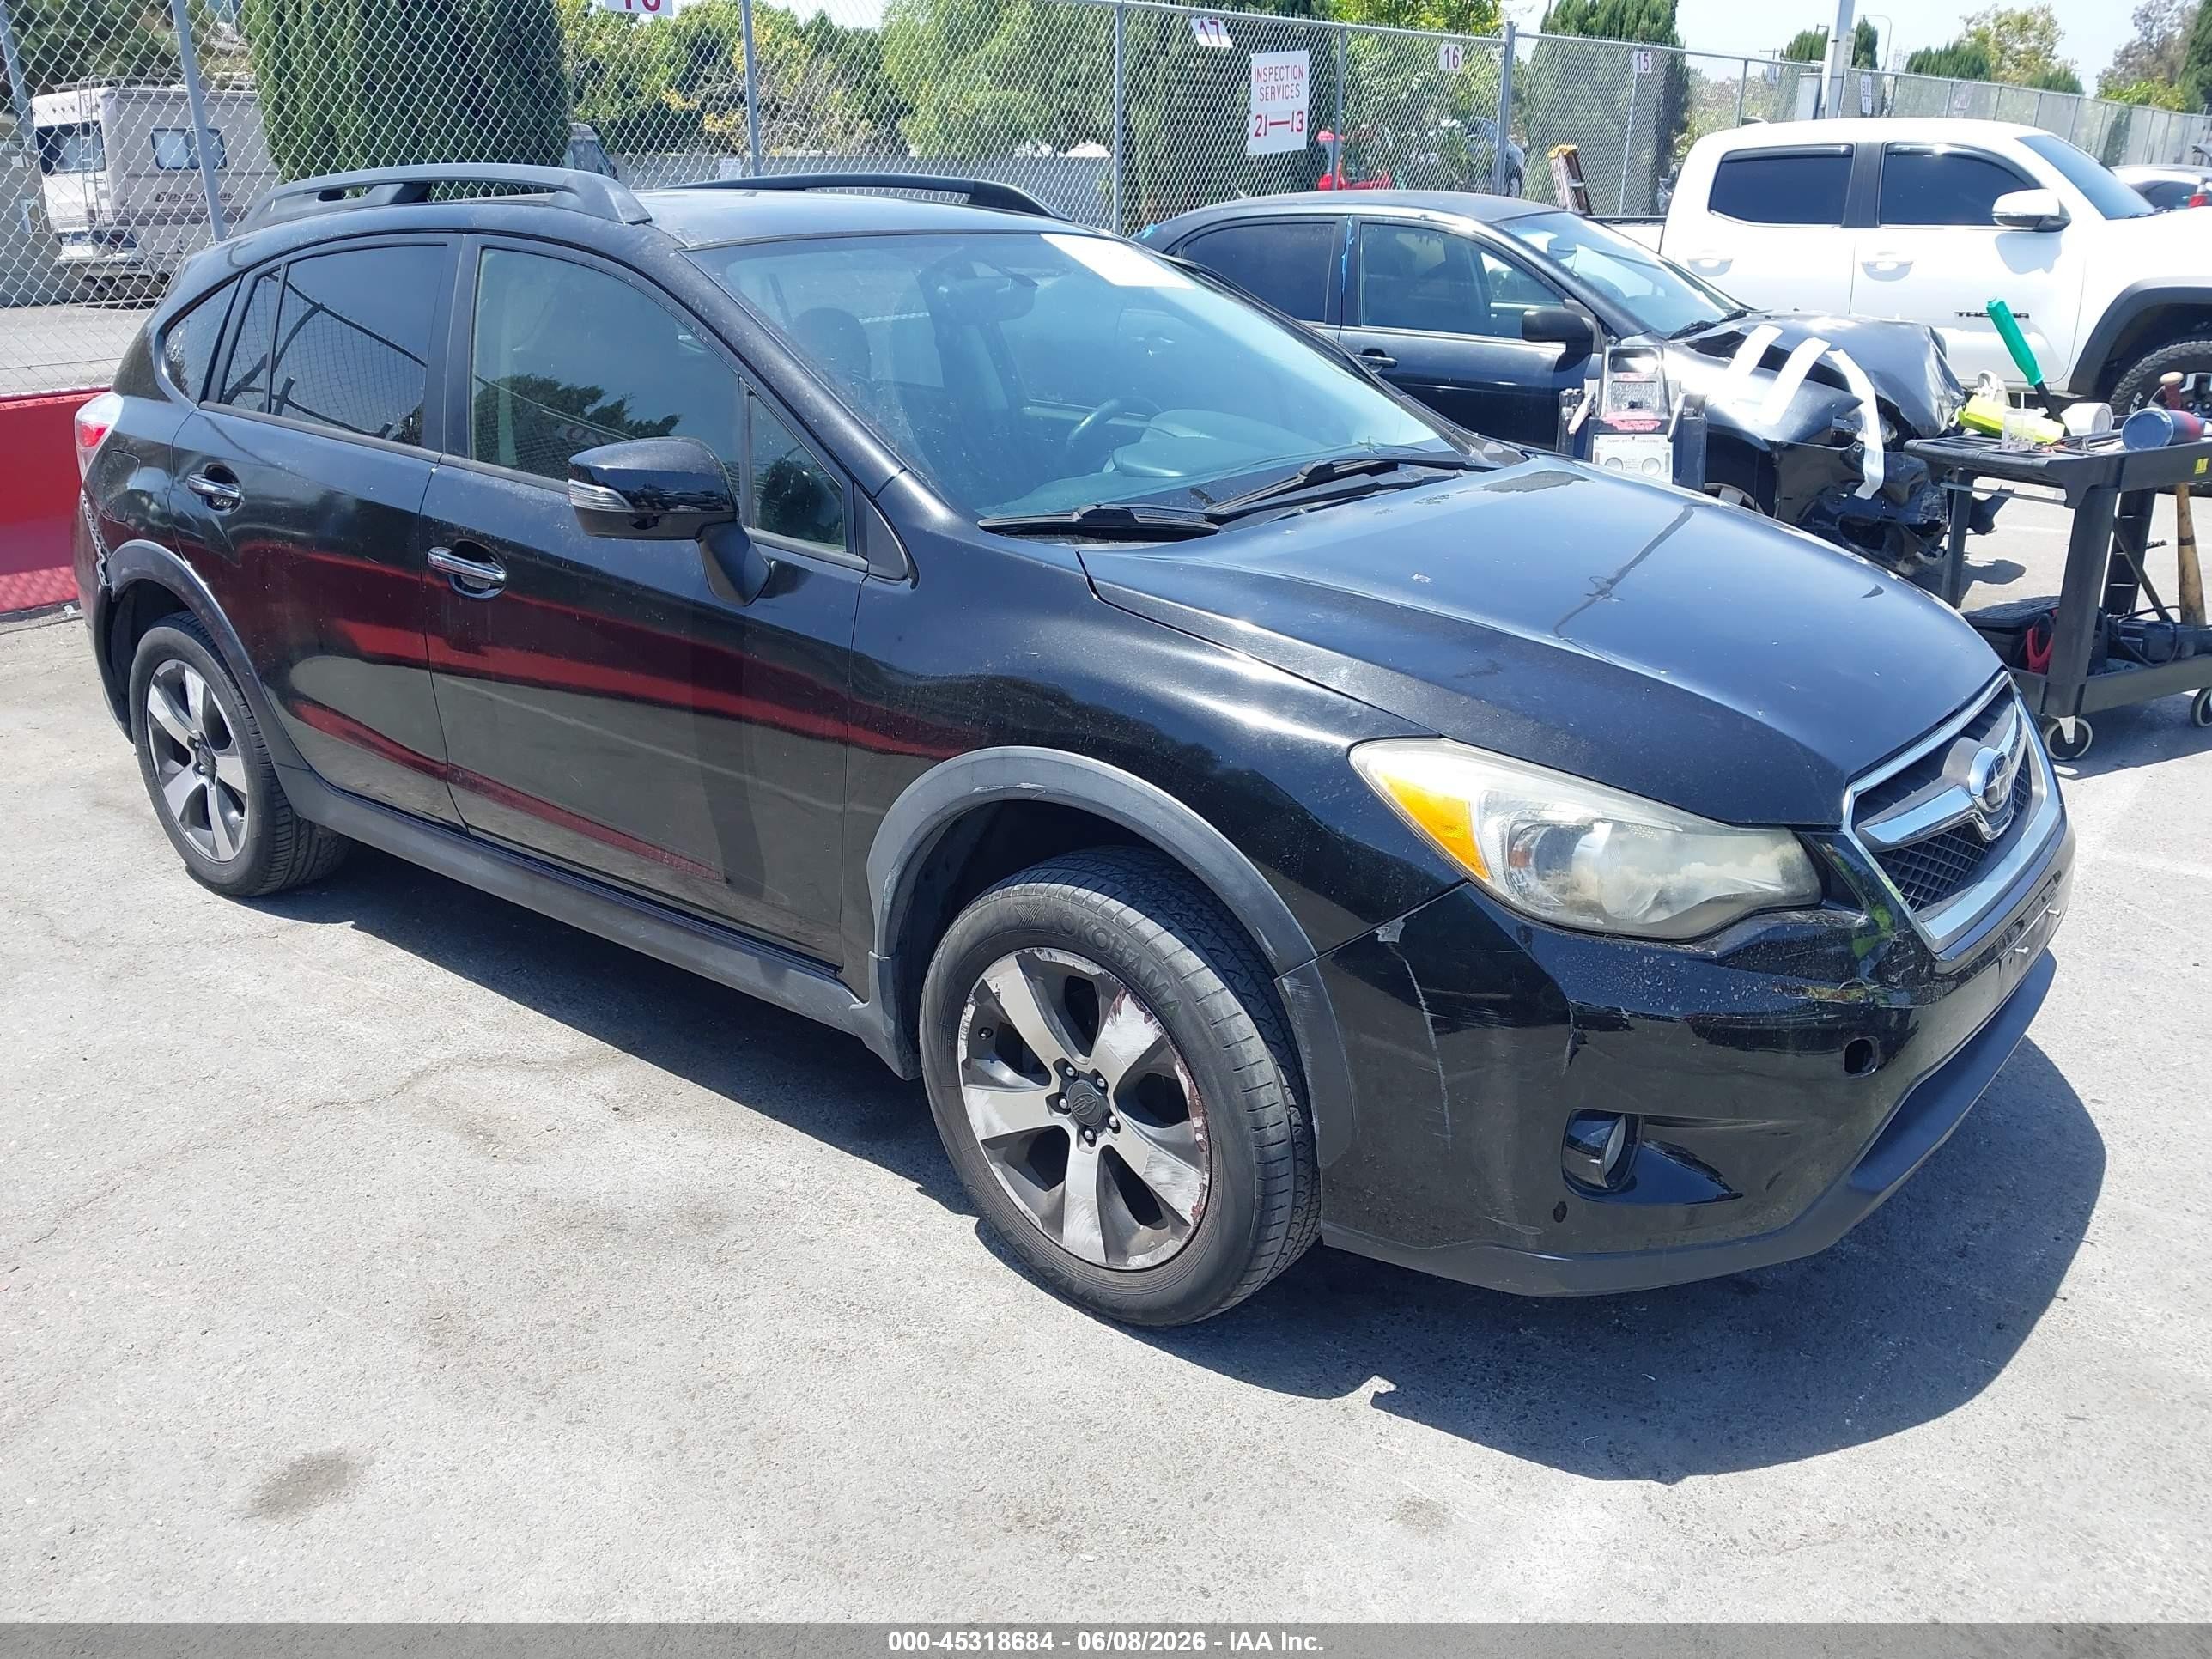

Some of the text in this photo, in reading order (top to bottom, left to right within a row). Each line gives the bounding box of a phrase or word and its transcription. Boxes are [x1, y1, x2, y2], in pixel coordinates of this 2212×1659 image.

[1199, 20, 1223, 45] 17
[1443, 46, 1460, 70] 16
[1636, 54, 1650, 71] 15
[1254, 64, 1304, 83] INSPECTION
[1259, 83, 1301, 102] SERVICES
